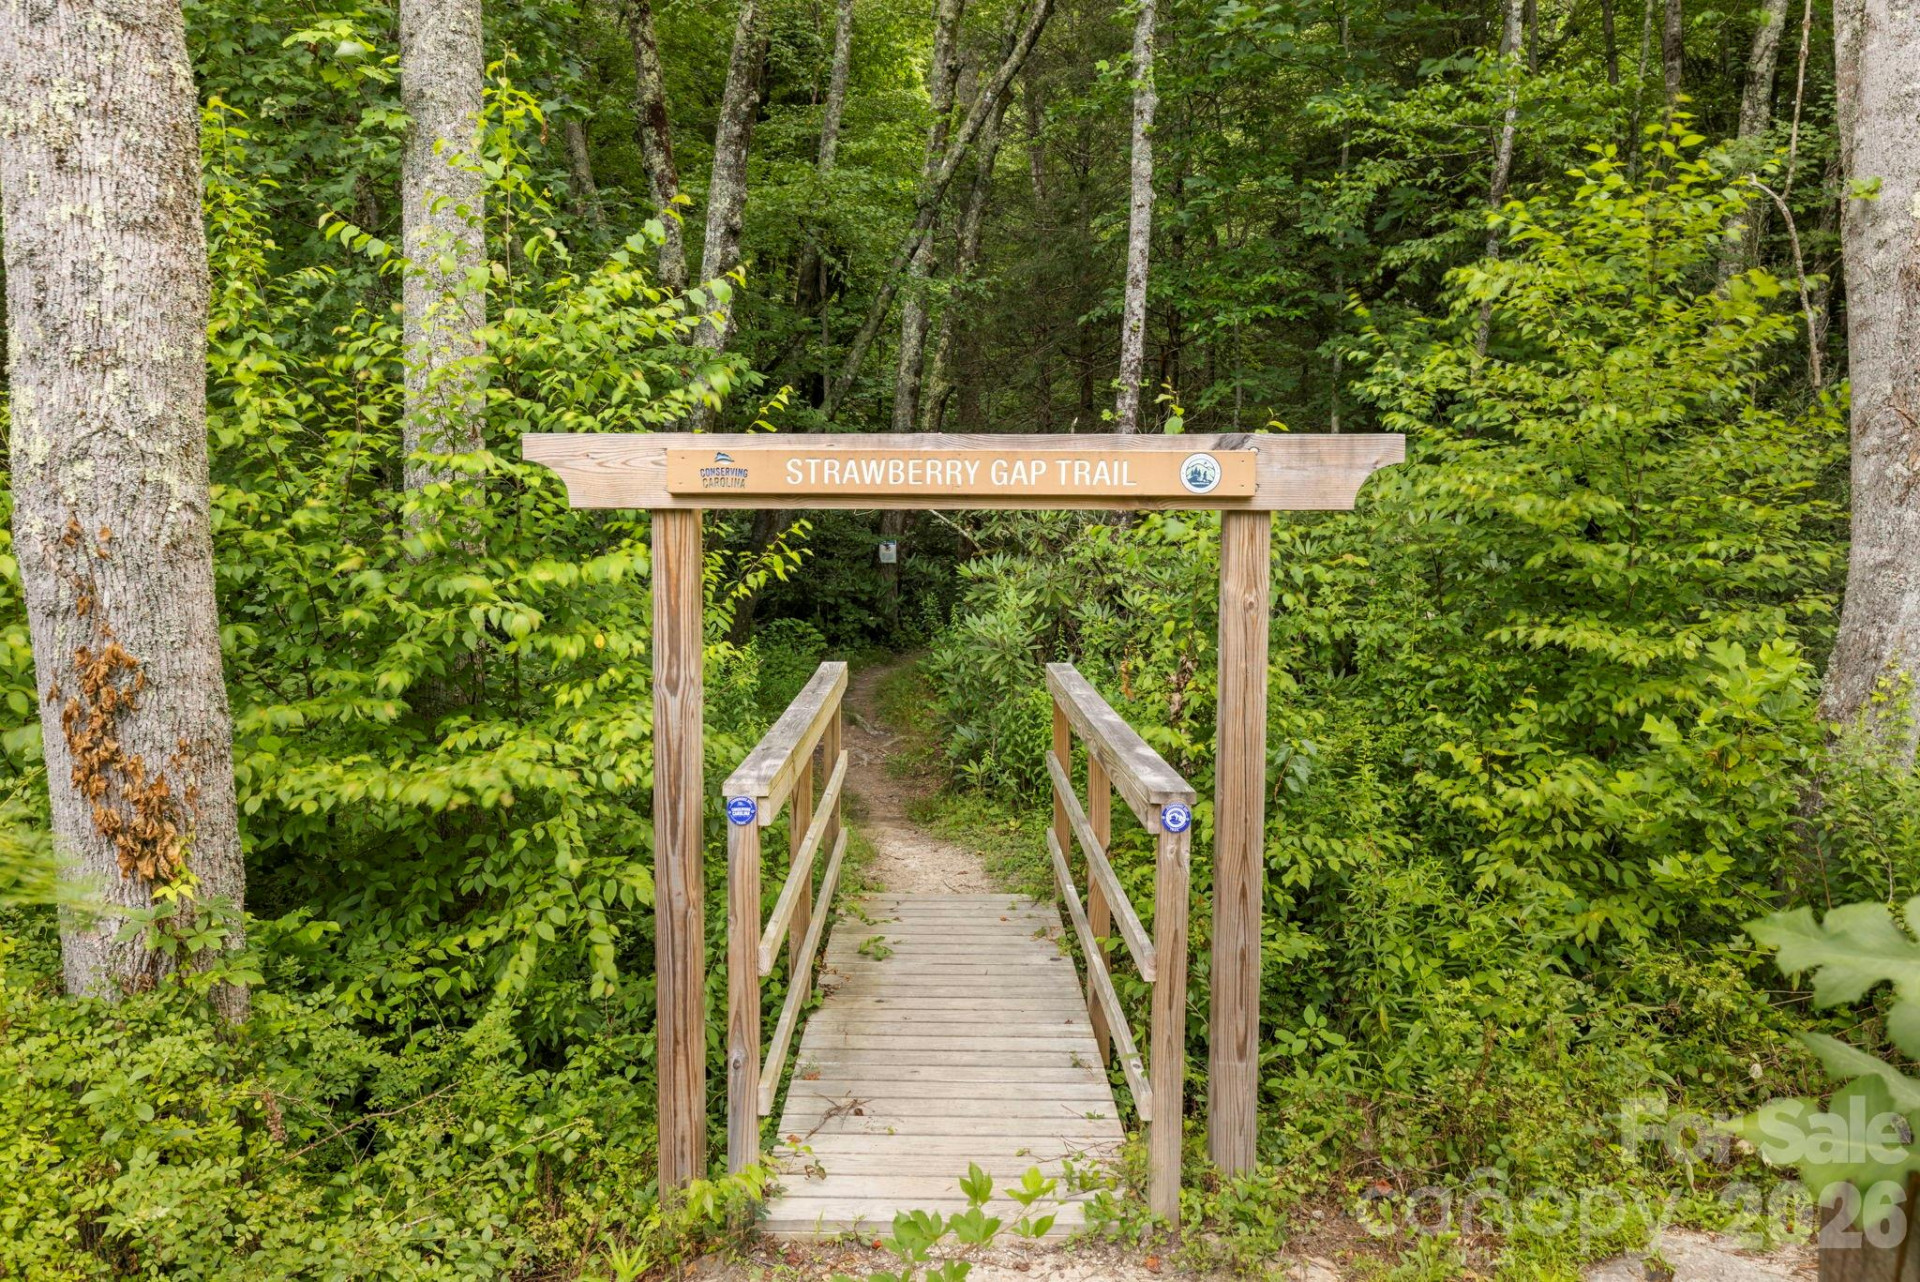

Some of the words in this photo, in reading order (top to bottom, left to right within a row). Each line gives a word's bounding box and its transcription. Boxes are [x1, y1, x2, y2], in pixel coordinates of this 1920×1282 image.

[700, 467, 748, 478] CONSERVING
[785, 457, 981, 486] STRAWBERRY
[990, 458, 1047, 486] GAP
[1055, 459, 1137, 486] TRAIL
[702, 477, 746, 488] CAROLINA
